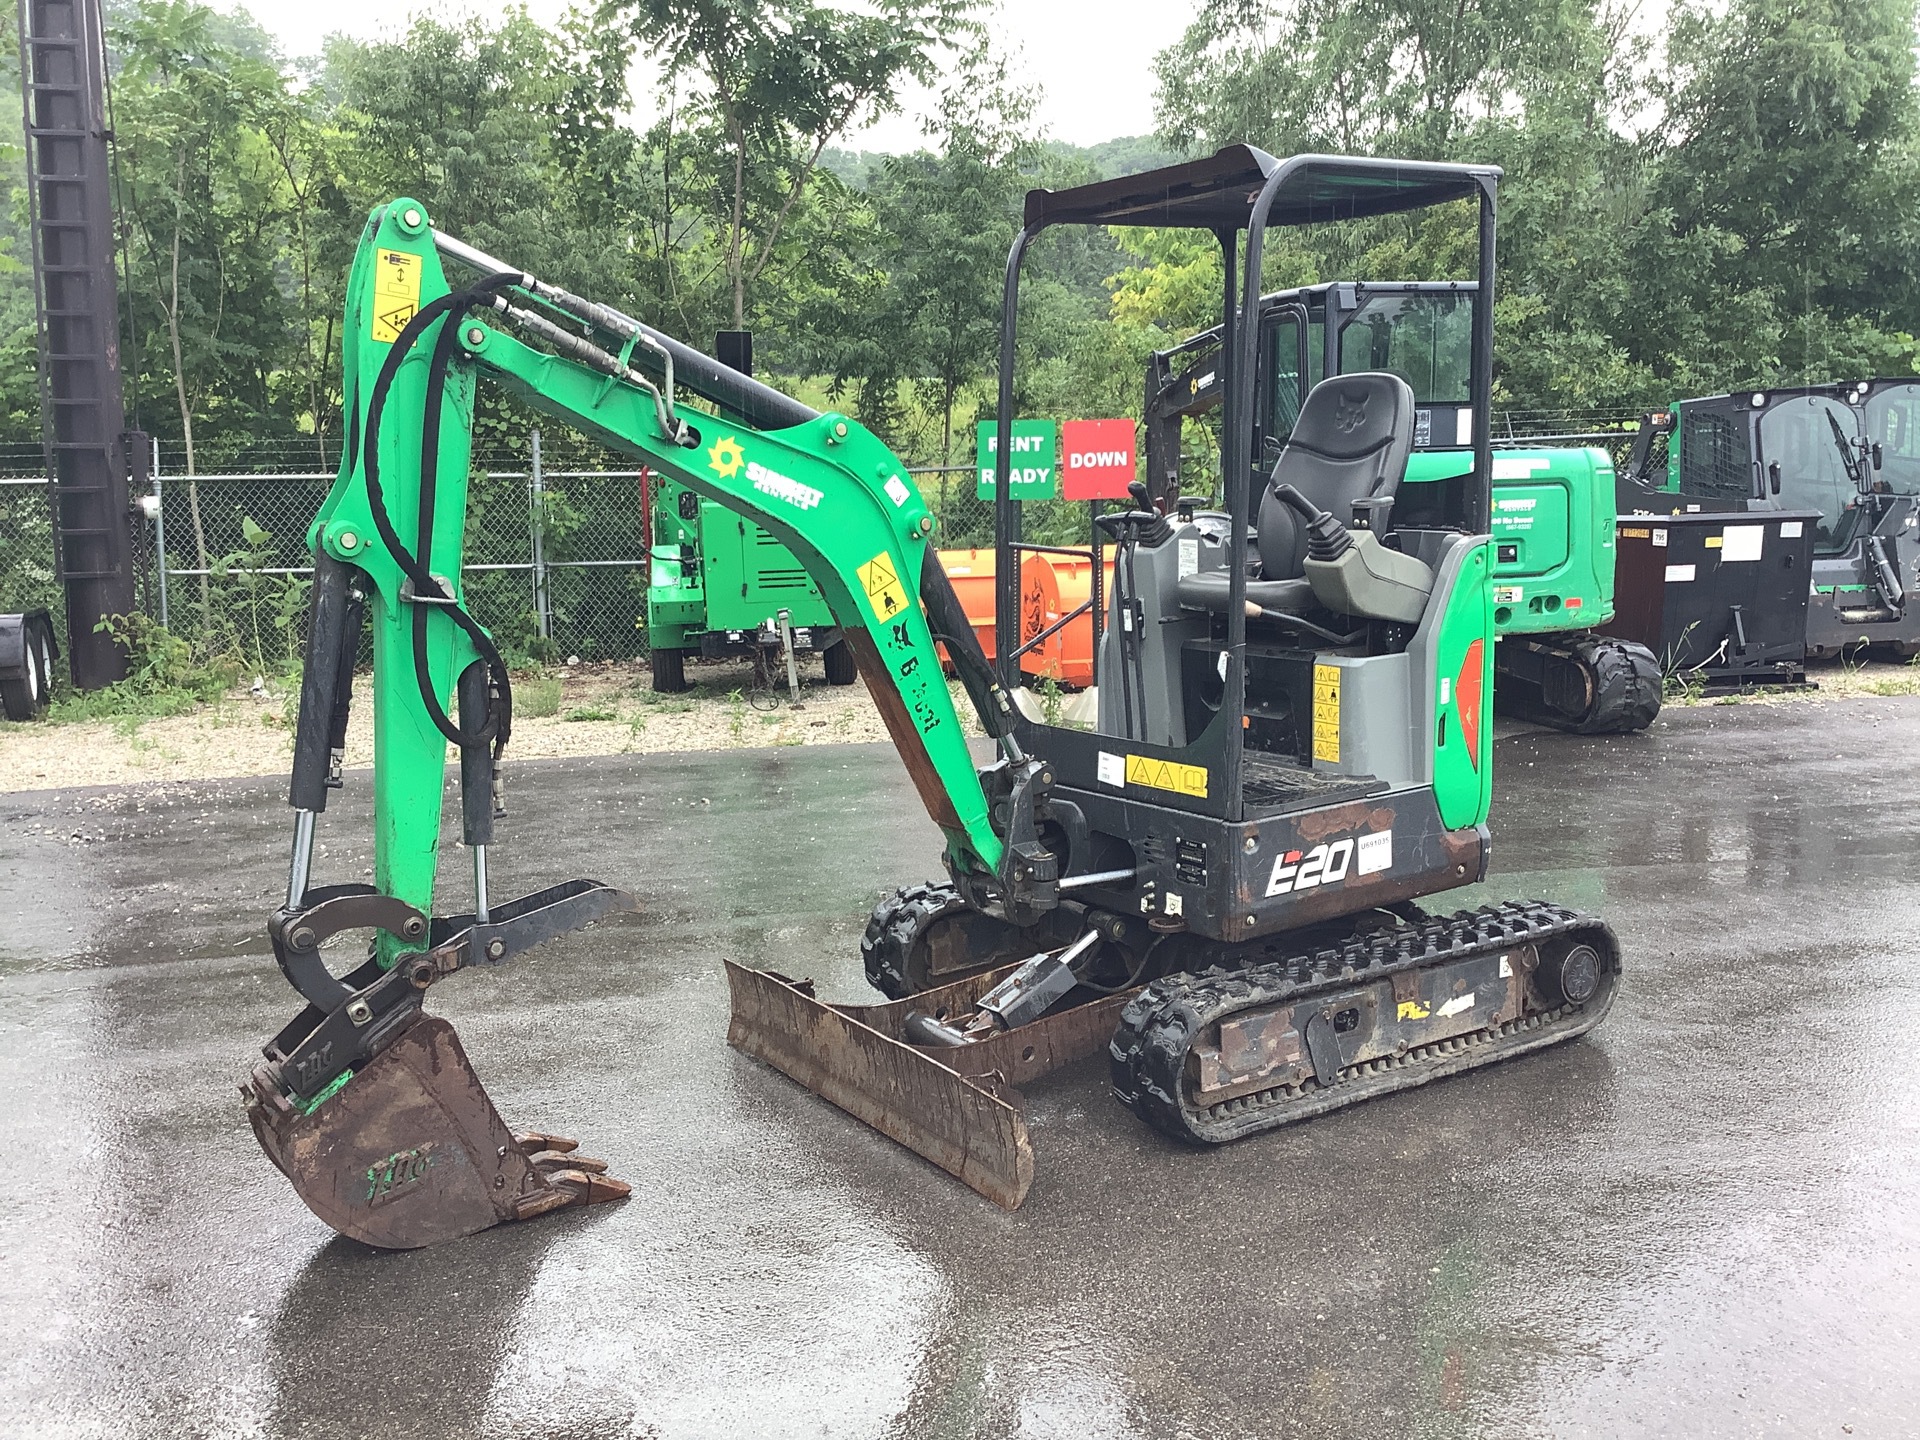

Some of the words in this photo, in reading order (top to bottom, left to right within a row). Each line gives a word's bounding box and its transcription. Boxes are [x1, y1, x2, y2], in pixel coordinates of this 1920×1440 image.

[1070, 451, 1128, 468] DOWN
[981, 468, 1050, 484] RADY
[1264, 838, 1355, 898] E20
